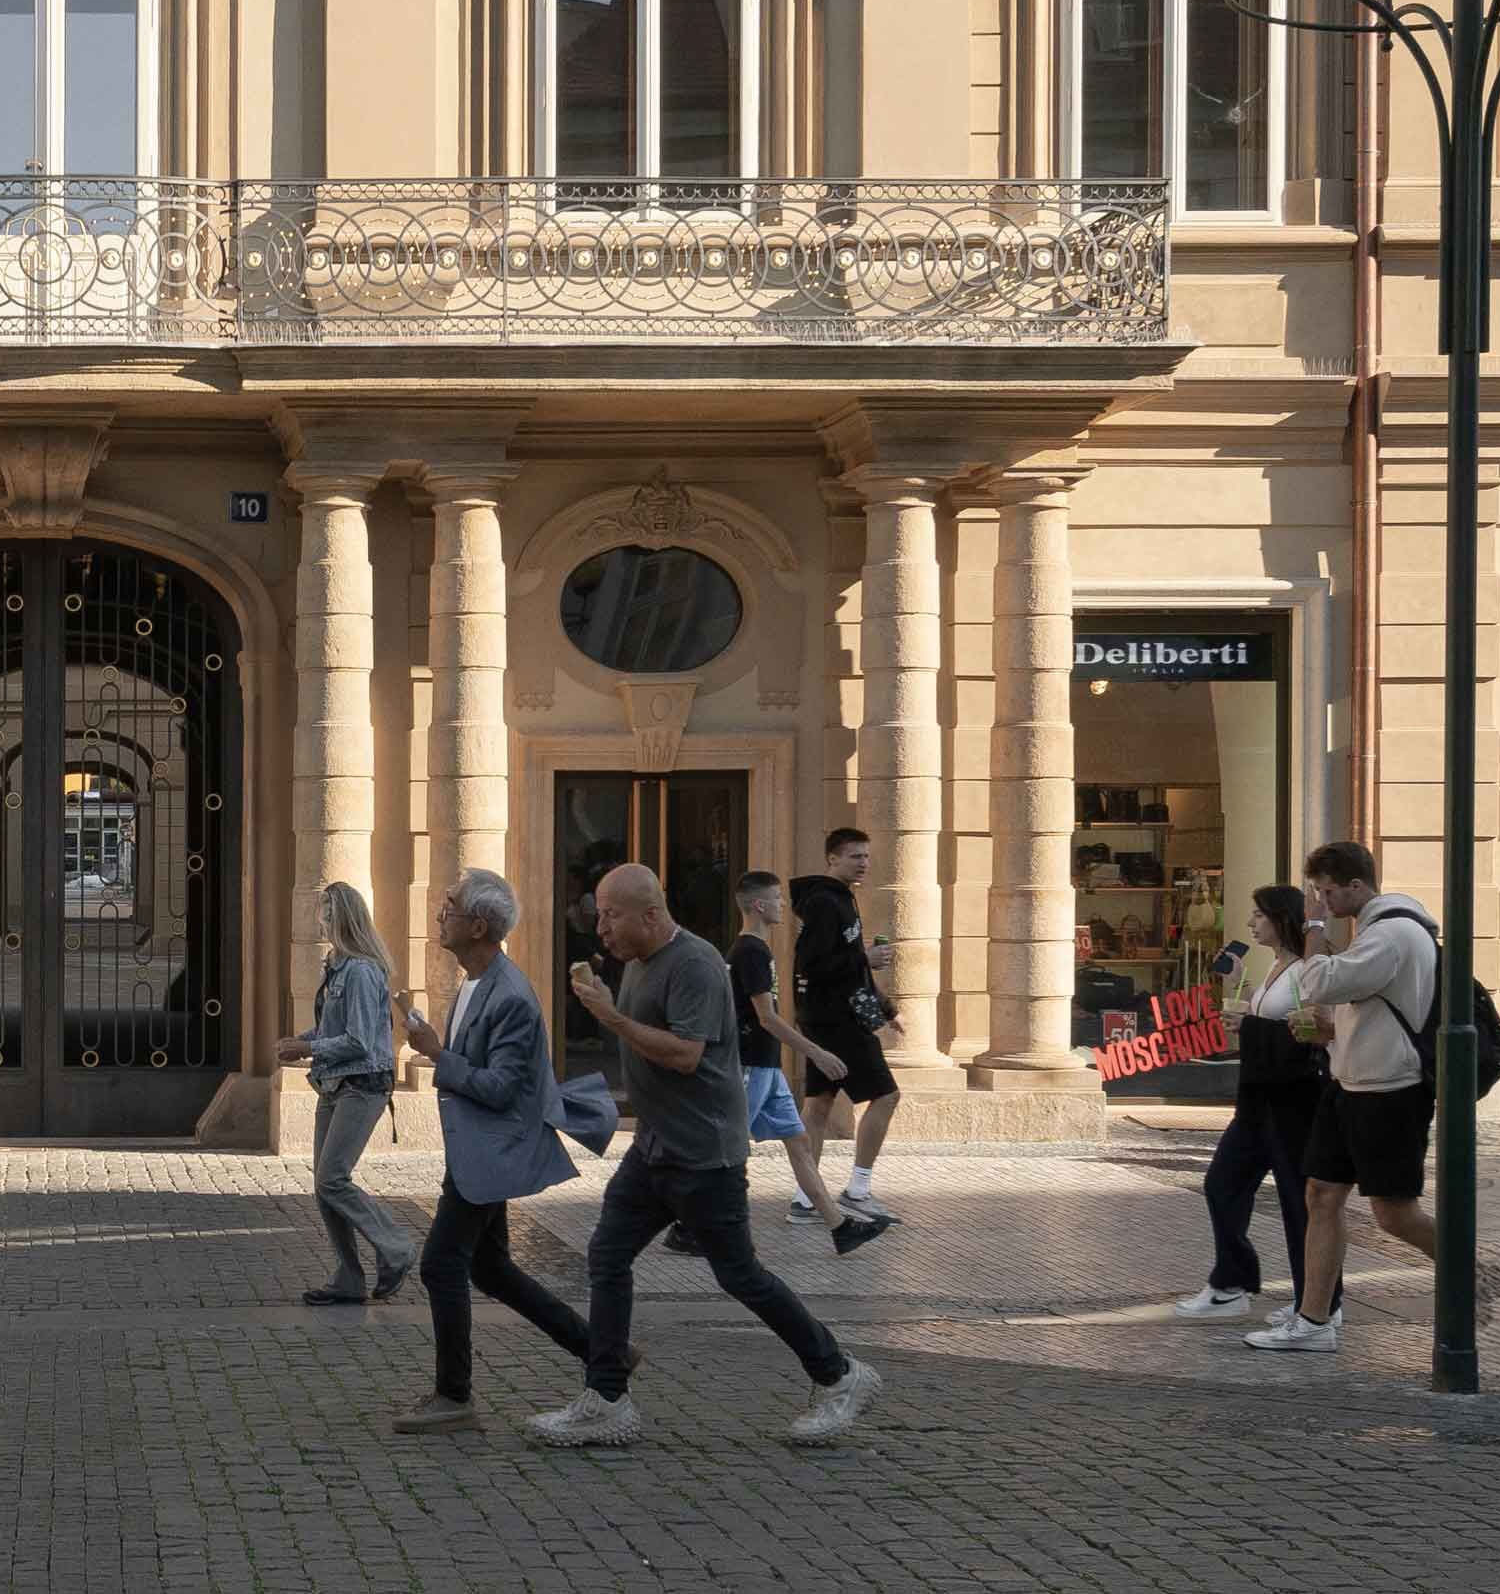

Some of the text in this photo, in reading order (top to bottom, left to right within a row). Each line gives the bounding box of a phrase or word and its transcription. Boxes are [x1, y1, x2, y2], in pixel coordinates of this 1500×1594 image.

[239, 498, 260, 517] 10
[1074, 641, 1249, 665] Deliberti
[1150, 982, 1221, 1031] LOVE
[1092, 1018, 1228, 1082] MOSCHINO
